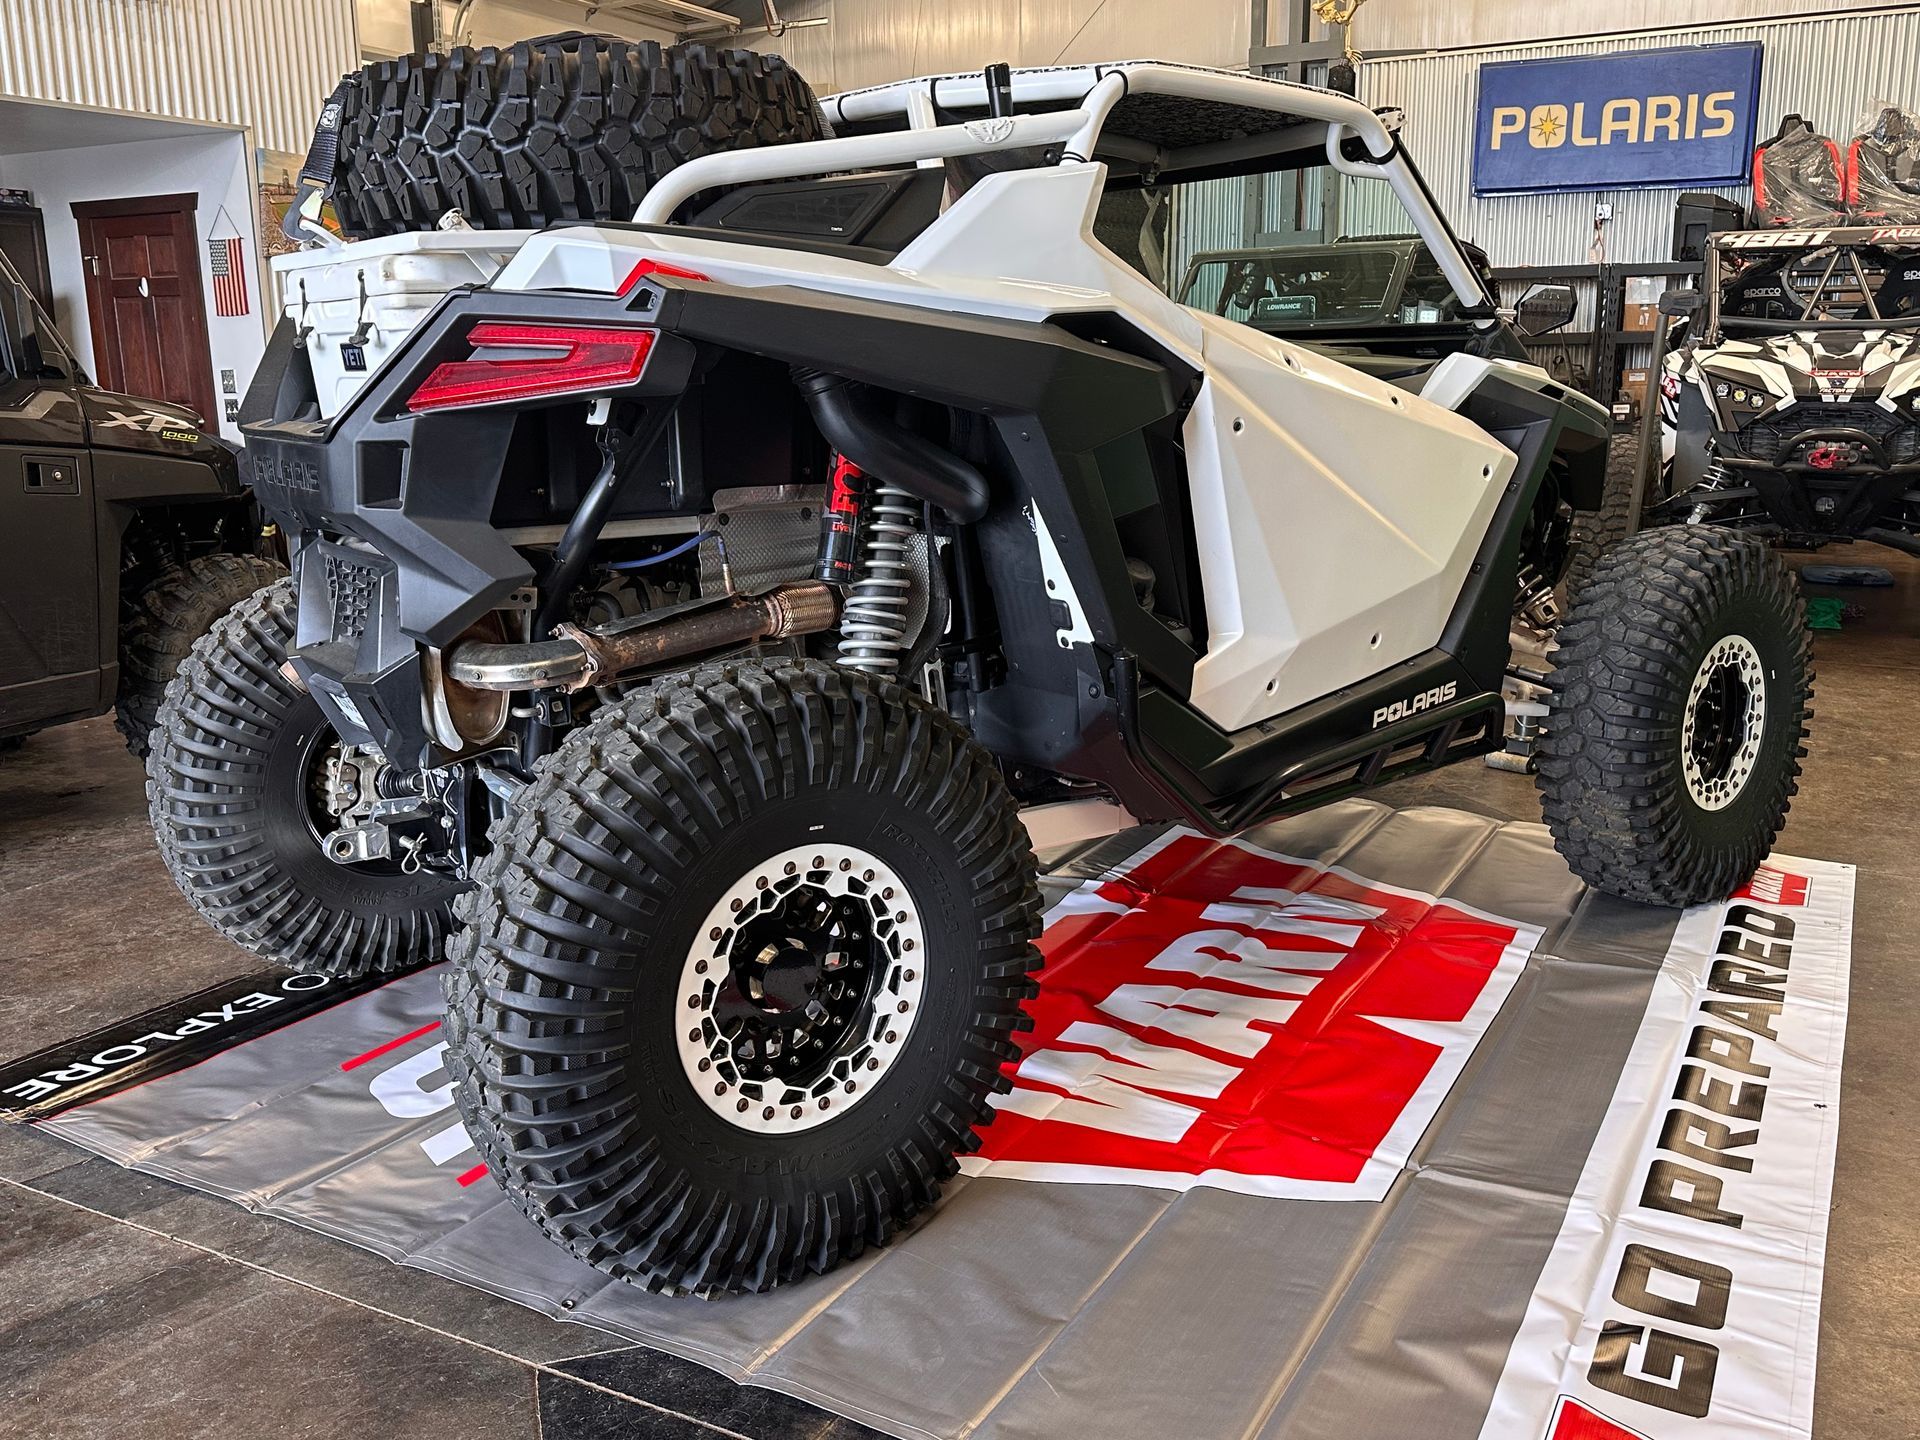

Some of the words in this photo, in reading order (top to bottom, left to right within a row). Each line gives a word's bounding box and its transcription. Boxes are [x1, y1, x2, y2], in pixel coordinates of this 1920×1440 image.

[1491, 91, 1736, 150] POLARIS
[1719, 231, 1832, 248] 4951
[1743, 287, 1782, 297] sparco
[342, 348, 365, 366] YETI
[98, 410, 196, 432] XP
[162, 430, 199, 440] 1000
[253, 455, 321, 493] POLARIS
[1372, 680, 1457, 729] POLARIS
[1749, 867, 1786, 903] WARN
[984, 886, 1389, 1144] WARN
[2, 992, 286, 1100] EXPLORE
[1638, 904, 1797, 1230] PREPARED
[1586, 1243, 1733, 1419] GO
